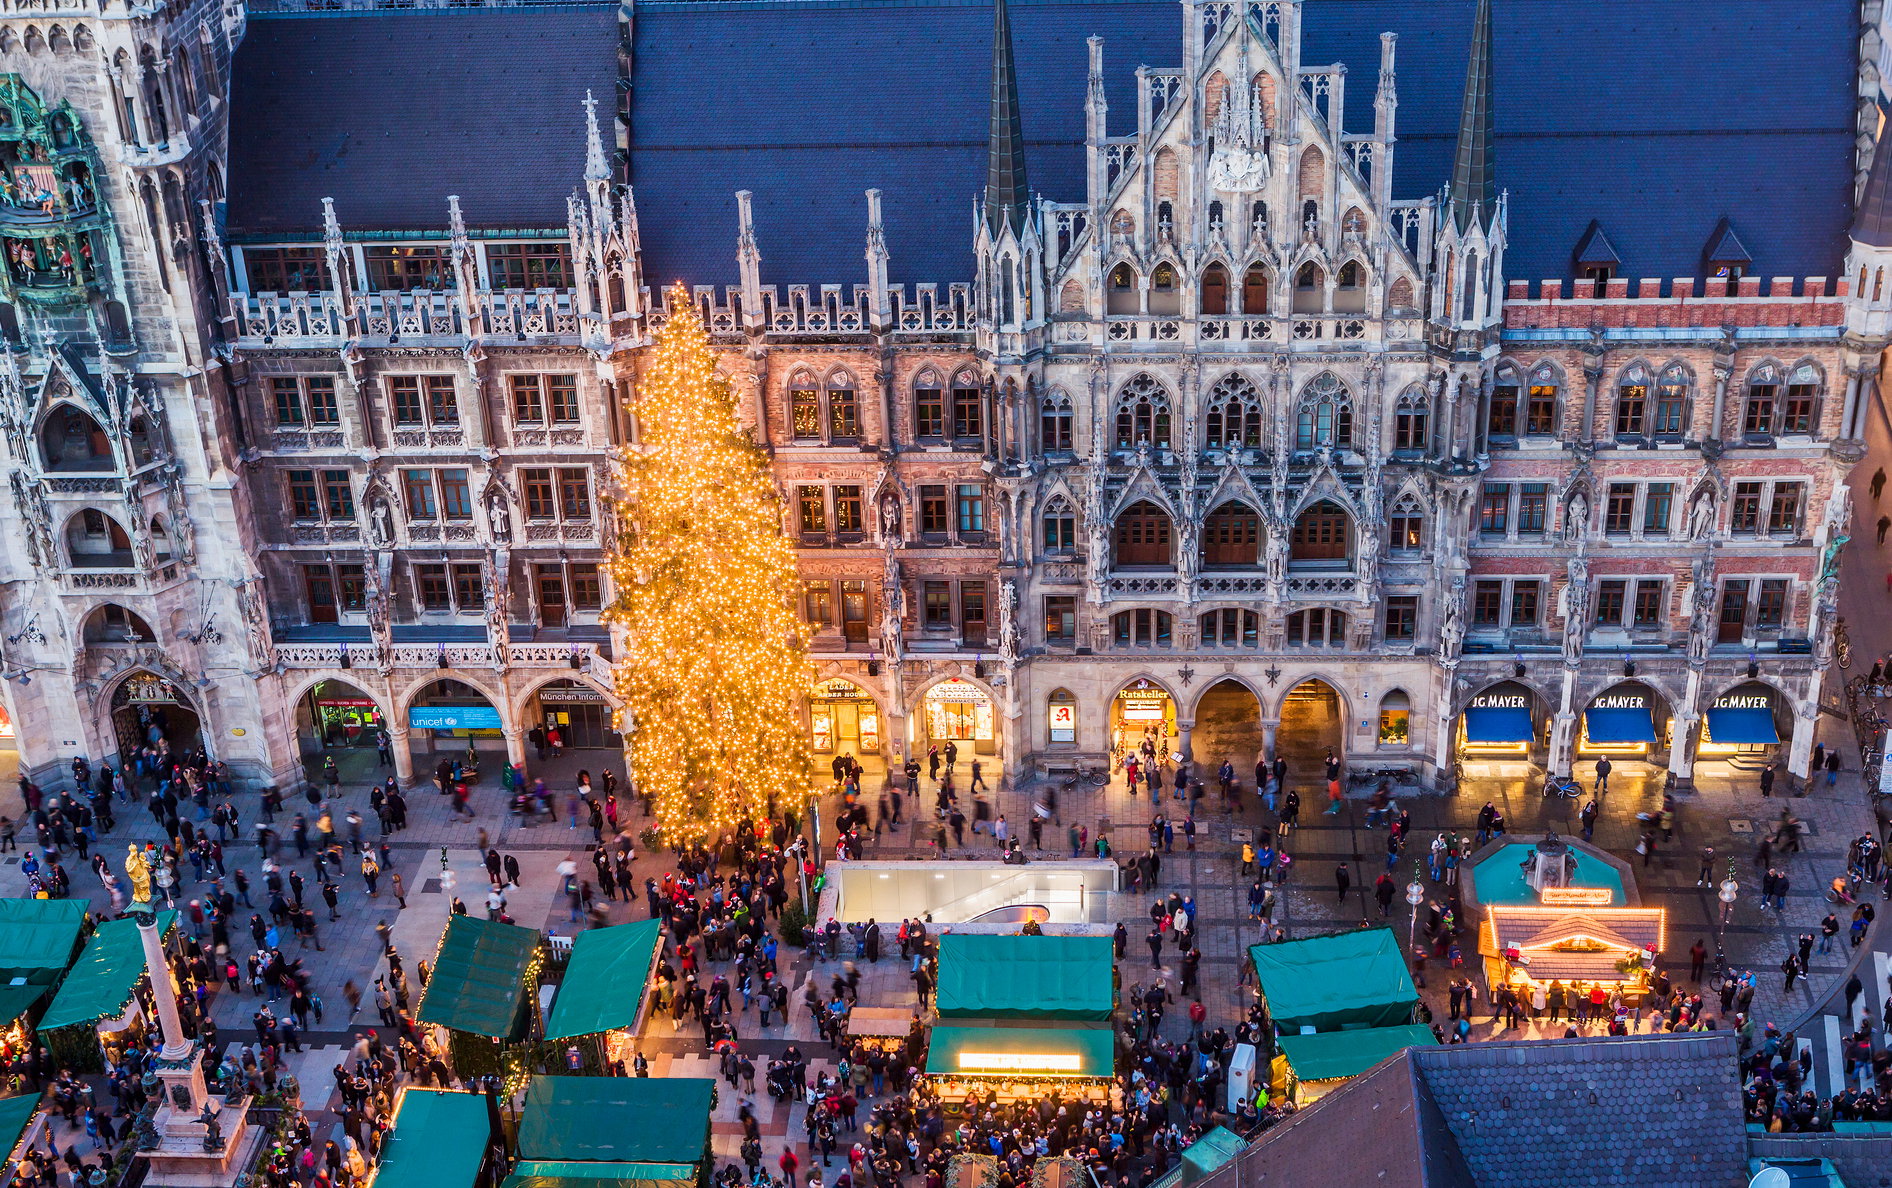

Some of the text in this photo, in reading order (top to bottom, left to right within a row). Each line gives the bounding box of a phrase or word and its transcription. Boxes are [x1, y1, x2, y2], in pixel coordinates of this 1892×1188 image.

[540, 693, 577, 701] München
[1119, 690, 1169, 699] Ratskeller
[1488, 695, 1525, 708] MAYER
[1606, 695, 1644, 708] MAYER
[1728, 695, 1768, 708] MAYER
[412, 717, 443, 727] unicef
